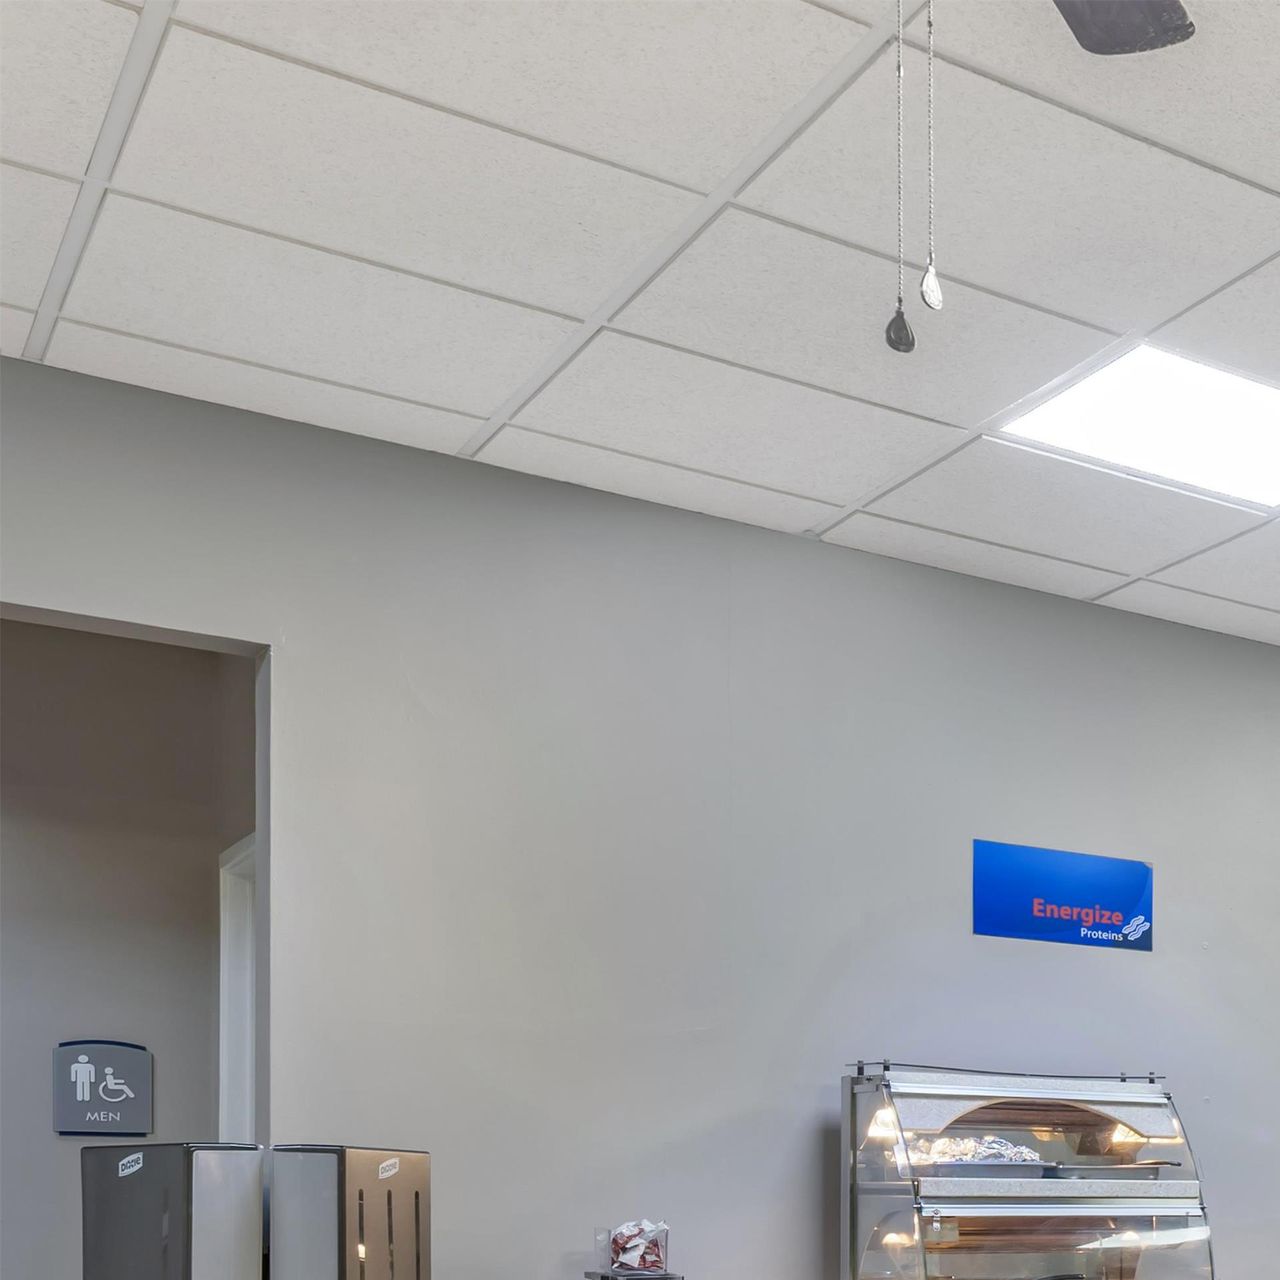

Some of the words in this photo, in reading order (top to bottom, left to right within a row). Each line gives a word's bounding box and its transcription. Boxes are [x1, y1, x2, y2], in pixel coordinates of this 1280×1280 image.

[1032, 898, 1124, 926] Energize
[1080, 927, 1124, 941] Proteins
[86, 1111, 121, 1122] MEN
